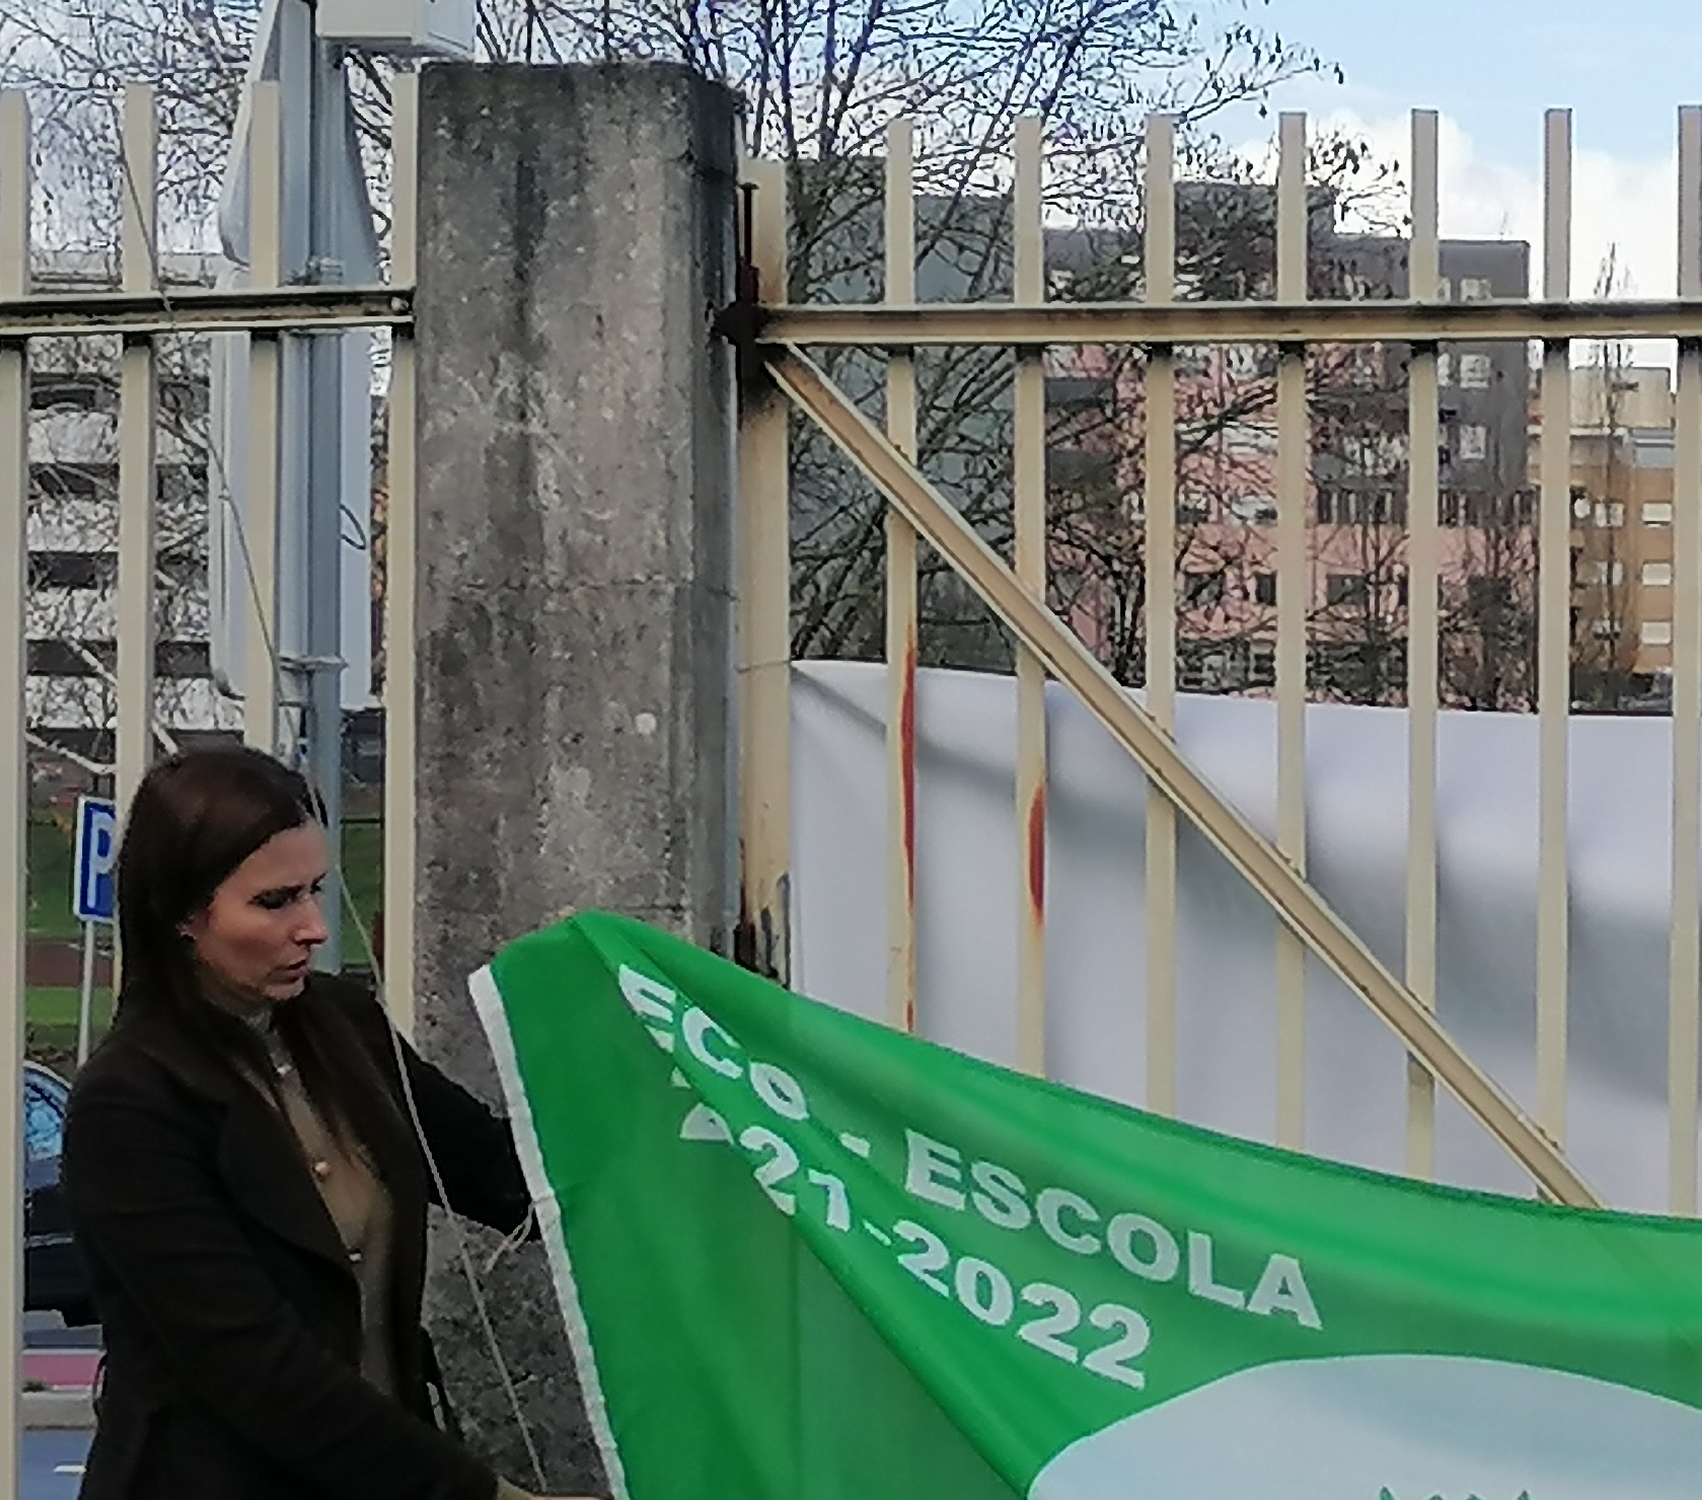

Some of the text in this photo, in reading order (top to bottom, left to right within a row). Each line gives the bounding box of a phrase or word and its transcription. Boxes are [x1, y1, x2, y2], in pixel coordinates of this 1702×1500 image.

[88, 807, 116, 908] P
[619, 963, 809, 1121] ECO
[906, 1130, 1322, 1330] ESCOLA
[672, 1067, 1151, 1390] 21-2022
